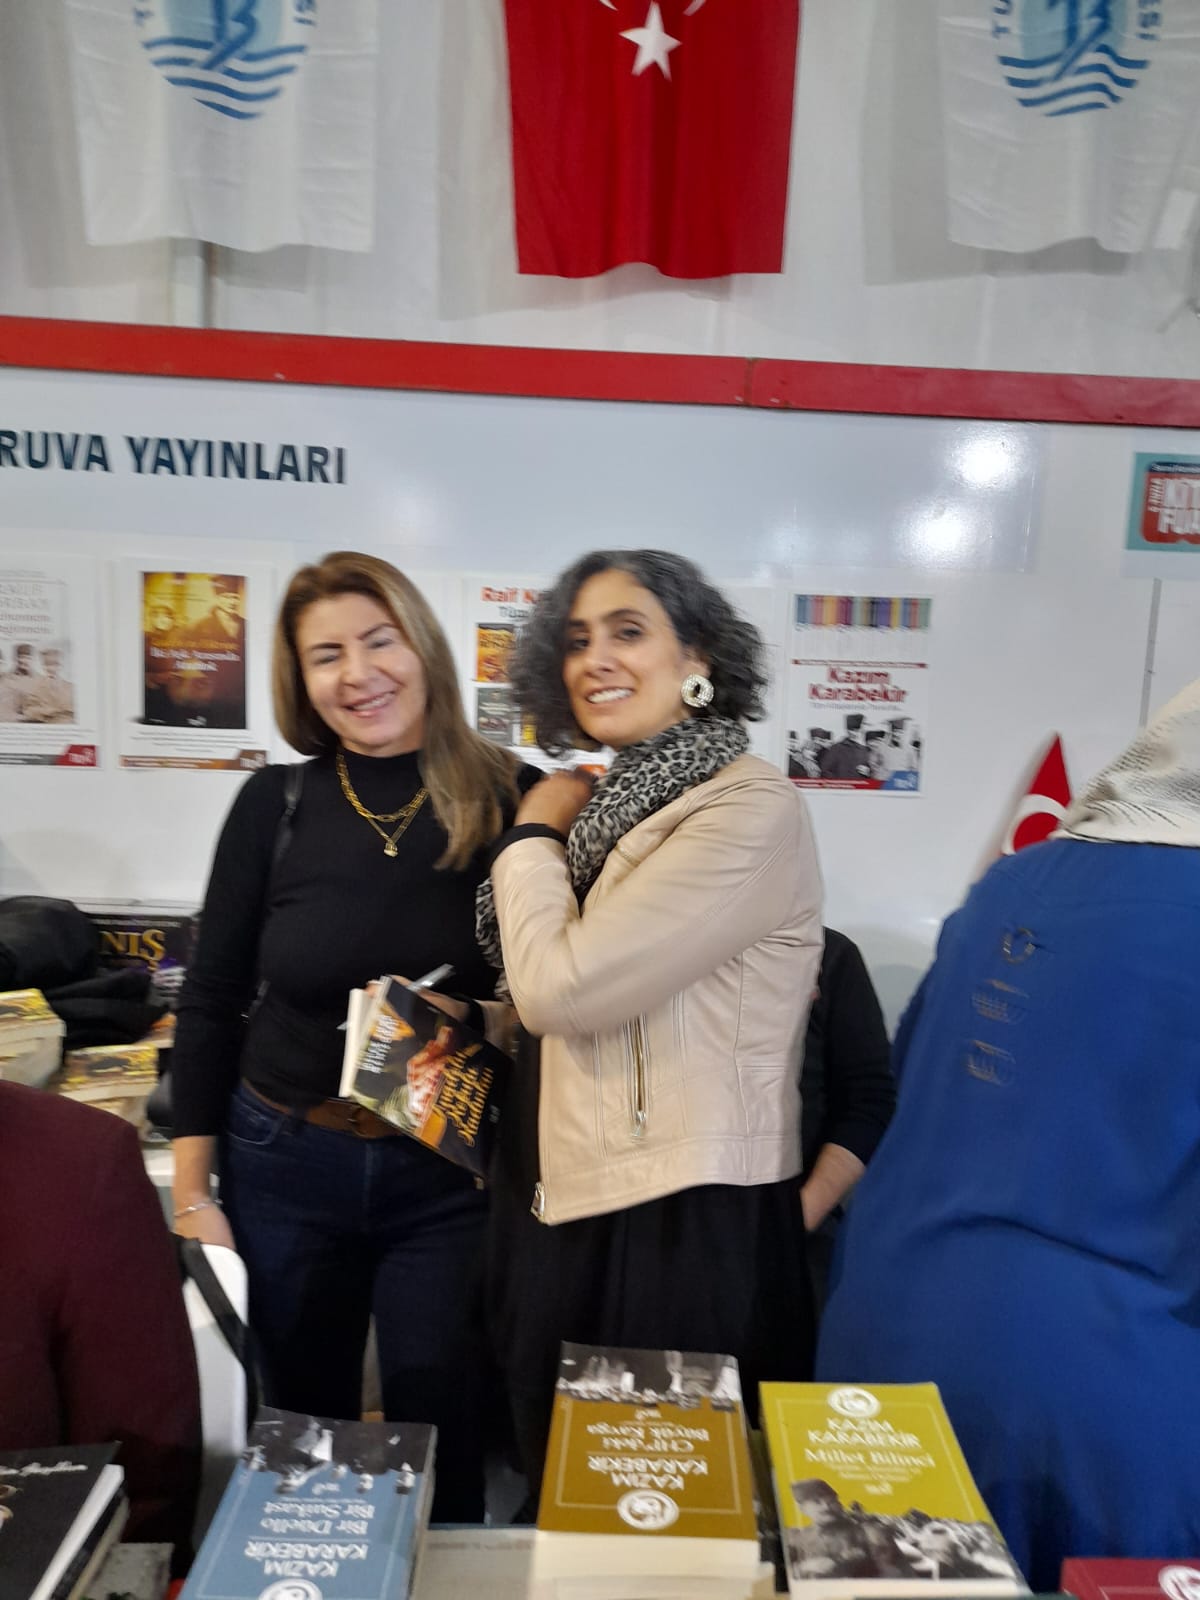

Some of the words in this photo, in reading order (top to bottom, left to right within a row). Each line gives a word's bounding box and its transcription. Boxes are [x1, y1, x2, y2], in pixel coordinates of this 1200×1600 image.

[0, 430, 112, 473] RUVA
[124, 435, 347, 484] YAYINLARI
[808, 683, 907, 703] Karabekir
[611, 1471, 685, 1490] KAZIM
[343, 1504, 375, 1520] Bir
[336, 1519, 369, 1535] Bir
[263, 1560, 339, 1578] KAZIM
